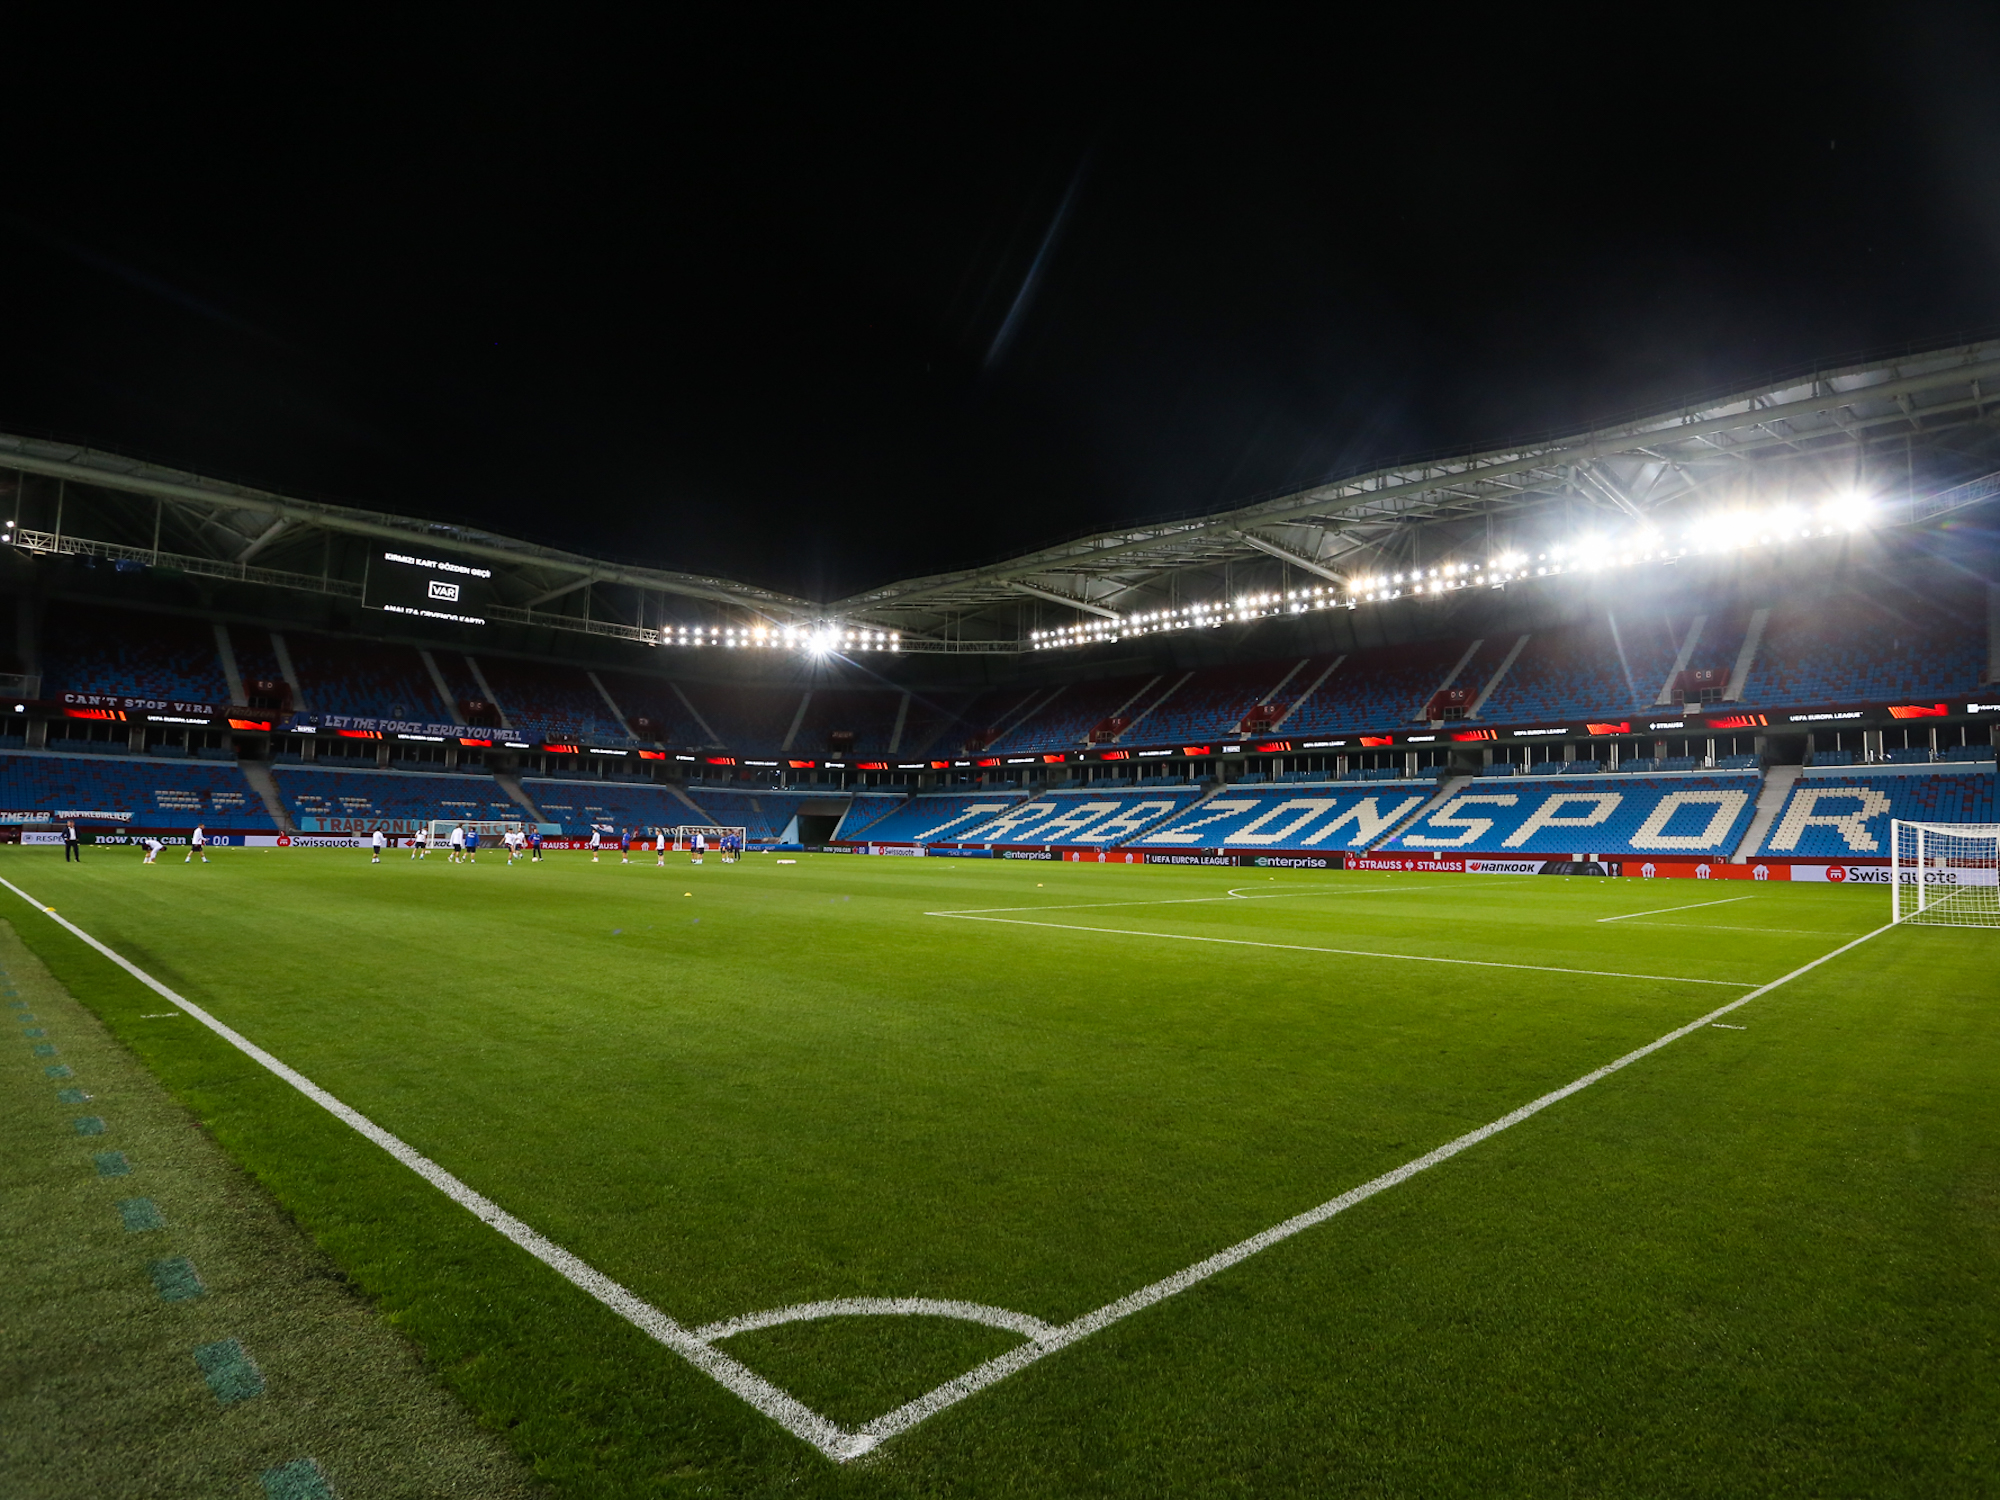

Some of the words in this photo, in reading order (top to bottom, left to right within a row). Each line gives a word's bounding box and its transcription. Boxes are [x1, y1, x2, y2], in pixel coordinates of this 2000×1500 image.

[416, 558, 437, 568] KART
[432, 585, 456, 597] VAR
[64, 693, 117, 707] CAN'T
[124, 698, 168, 710] STOP
[1789, 714, 1808, 722] UEFA
[324, 715, 351, 728] LET
[352, 717, 377, 730] THE
[378, 719, 422, 733] FORCE
[422, 723, 464, 737] SERVE
[465, 726, 492, 739] YOU
[492, 729, 522, 741] WELL
[1656, 722, 1684, 730] STRAUSS
[94, 835, 128, 844] now
[161, 835, 186, 845] can
[584, 842, 618, 850] STAUSS
[1004, 850, 1052, 860] enterprise
[1200, 857, 1230, 865] LEAGUE
[1256, 856, 1327, 869] enterprise
[1359, 859, 1403, 870] STRAUSS
[1416, 861, 1463, 872] STRAUSS
[1849, 867, 1958, 885] Swisquote
